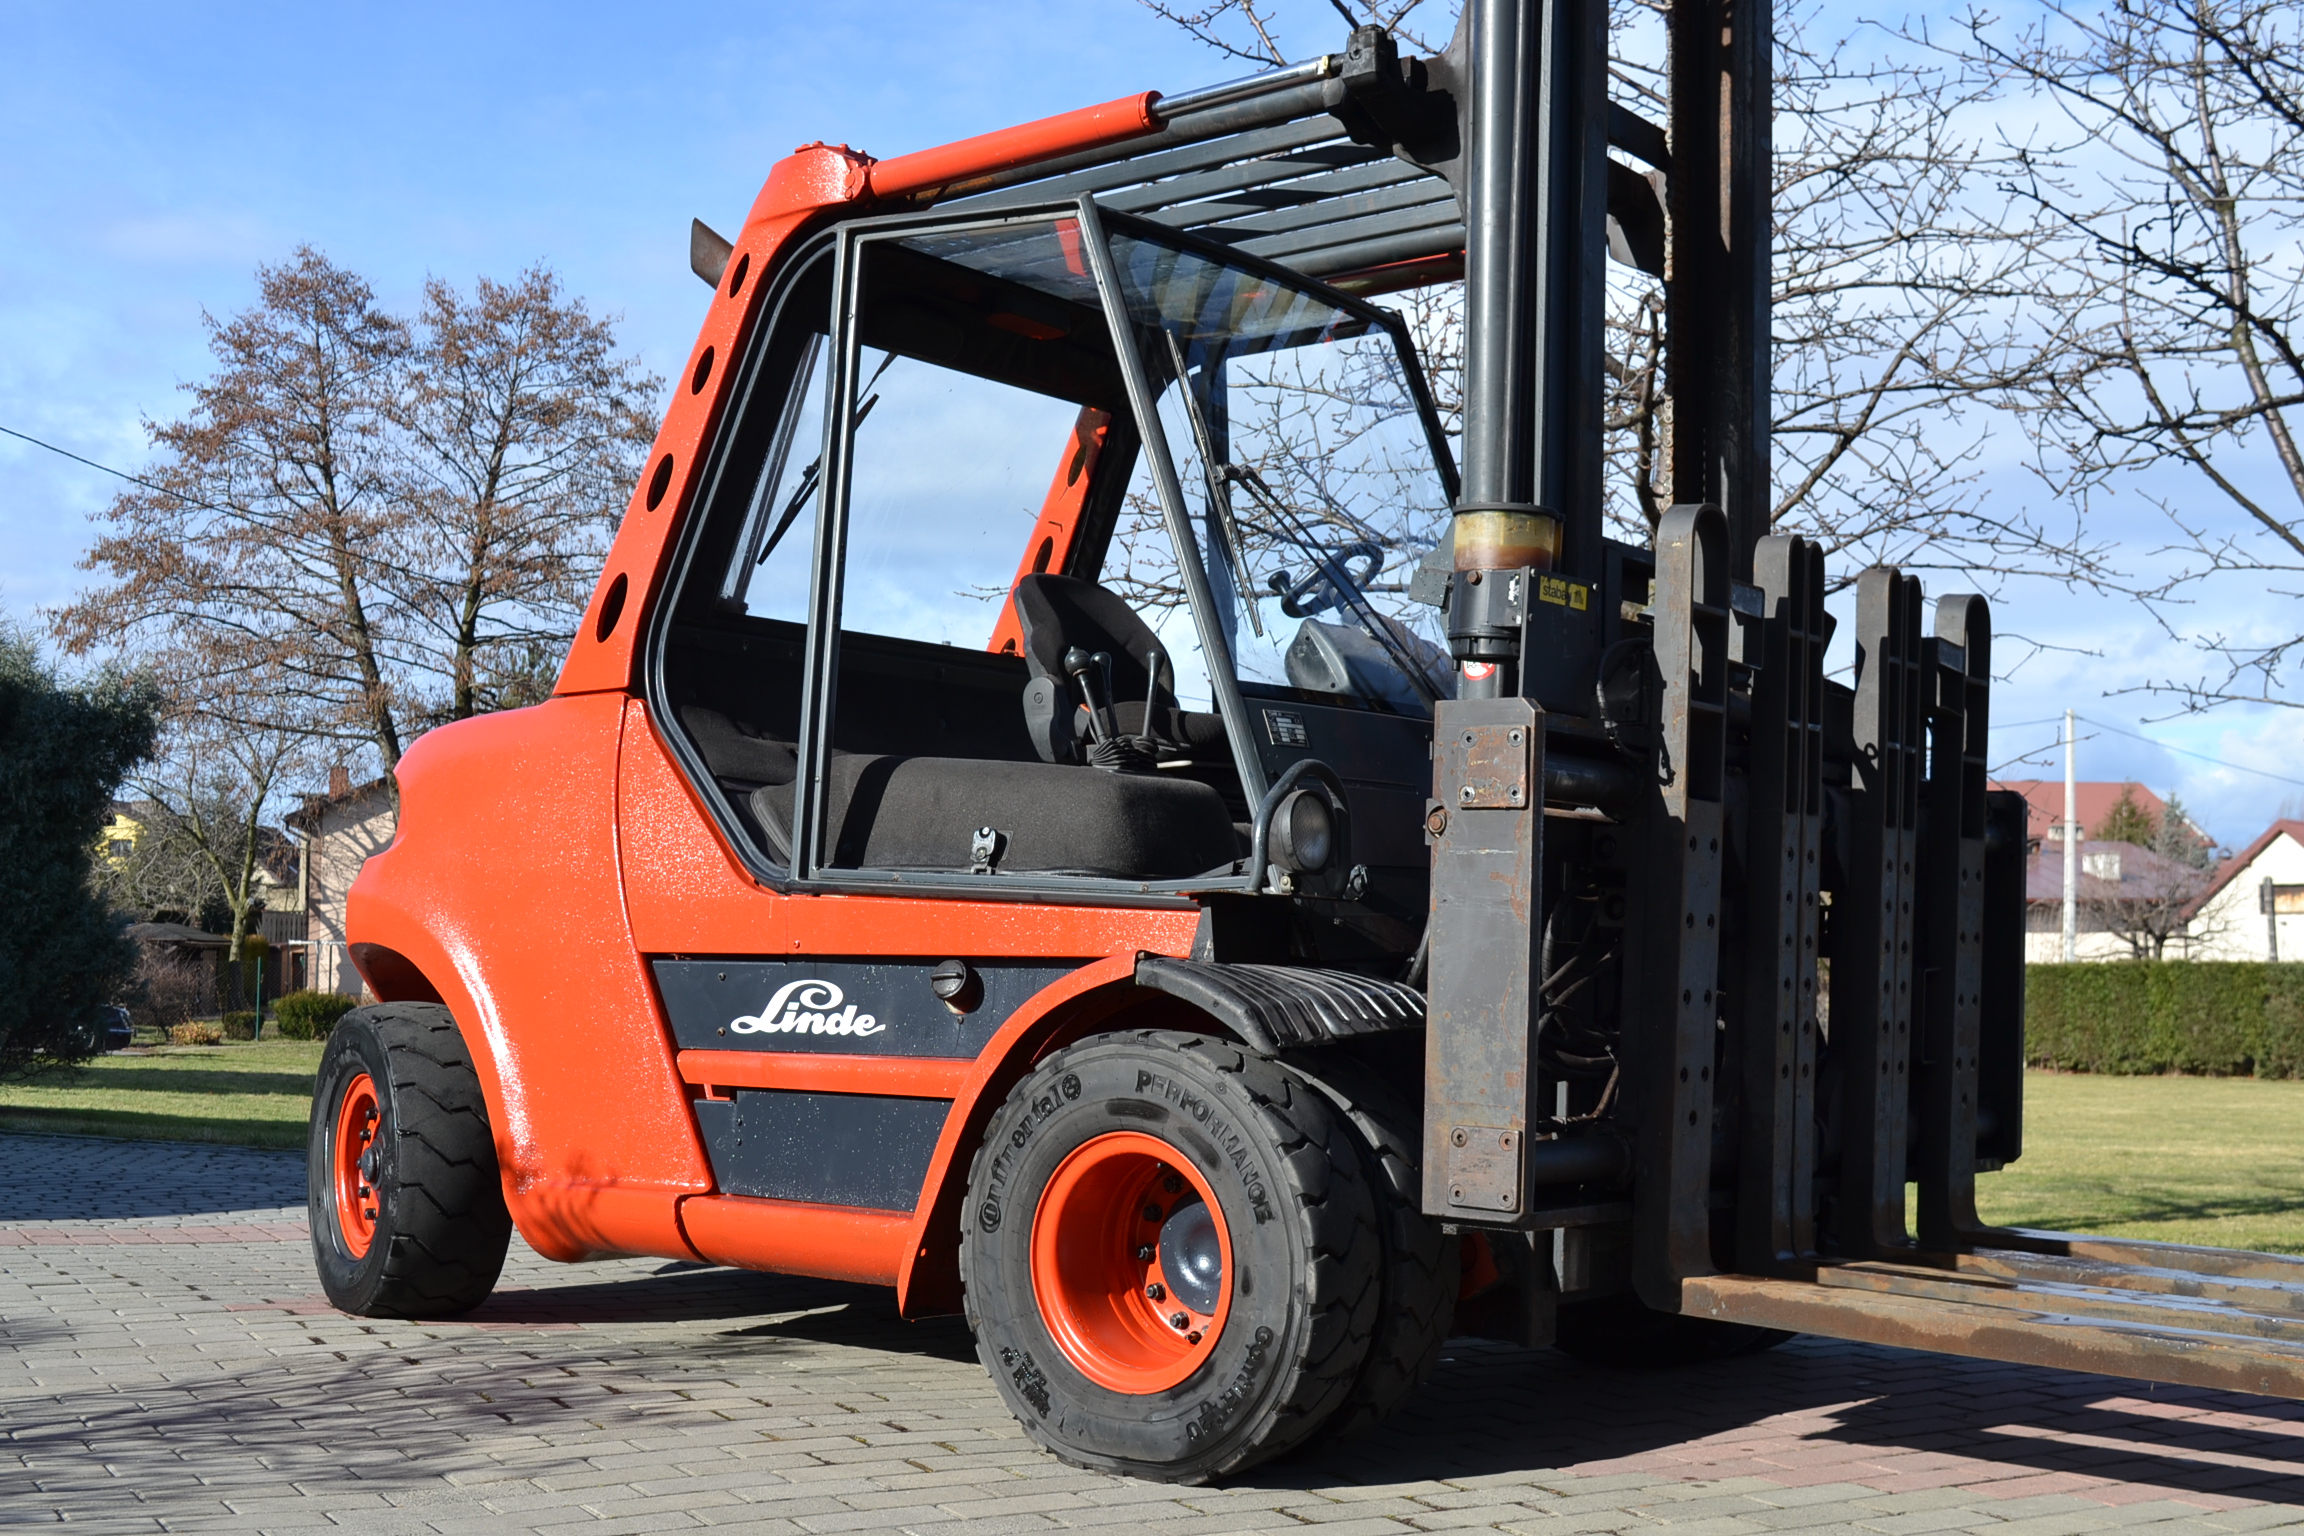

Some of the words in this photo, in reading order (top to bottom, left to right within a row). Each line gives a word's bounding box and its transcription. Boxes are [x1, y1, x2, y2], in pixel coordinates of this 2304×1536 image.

[1543, 584, 1571, 601] staba
[731, 979, 886, 1036] Linde
[979, 1084, 1065, 1233] Continental
[1135, 1069, 1276, 1225] PERFORMANCE
